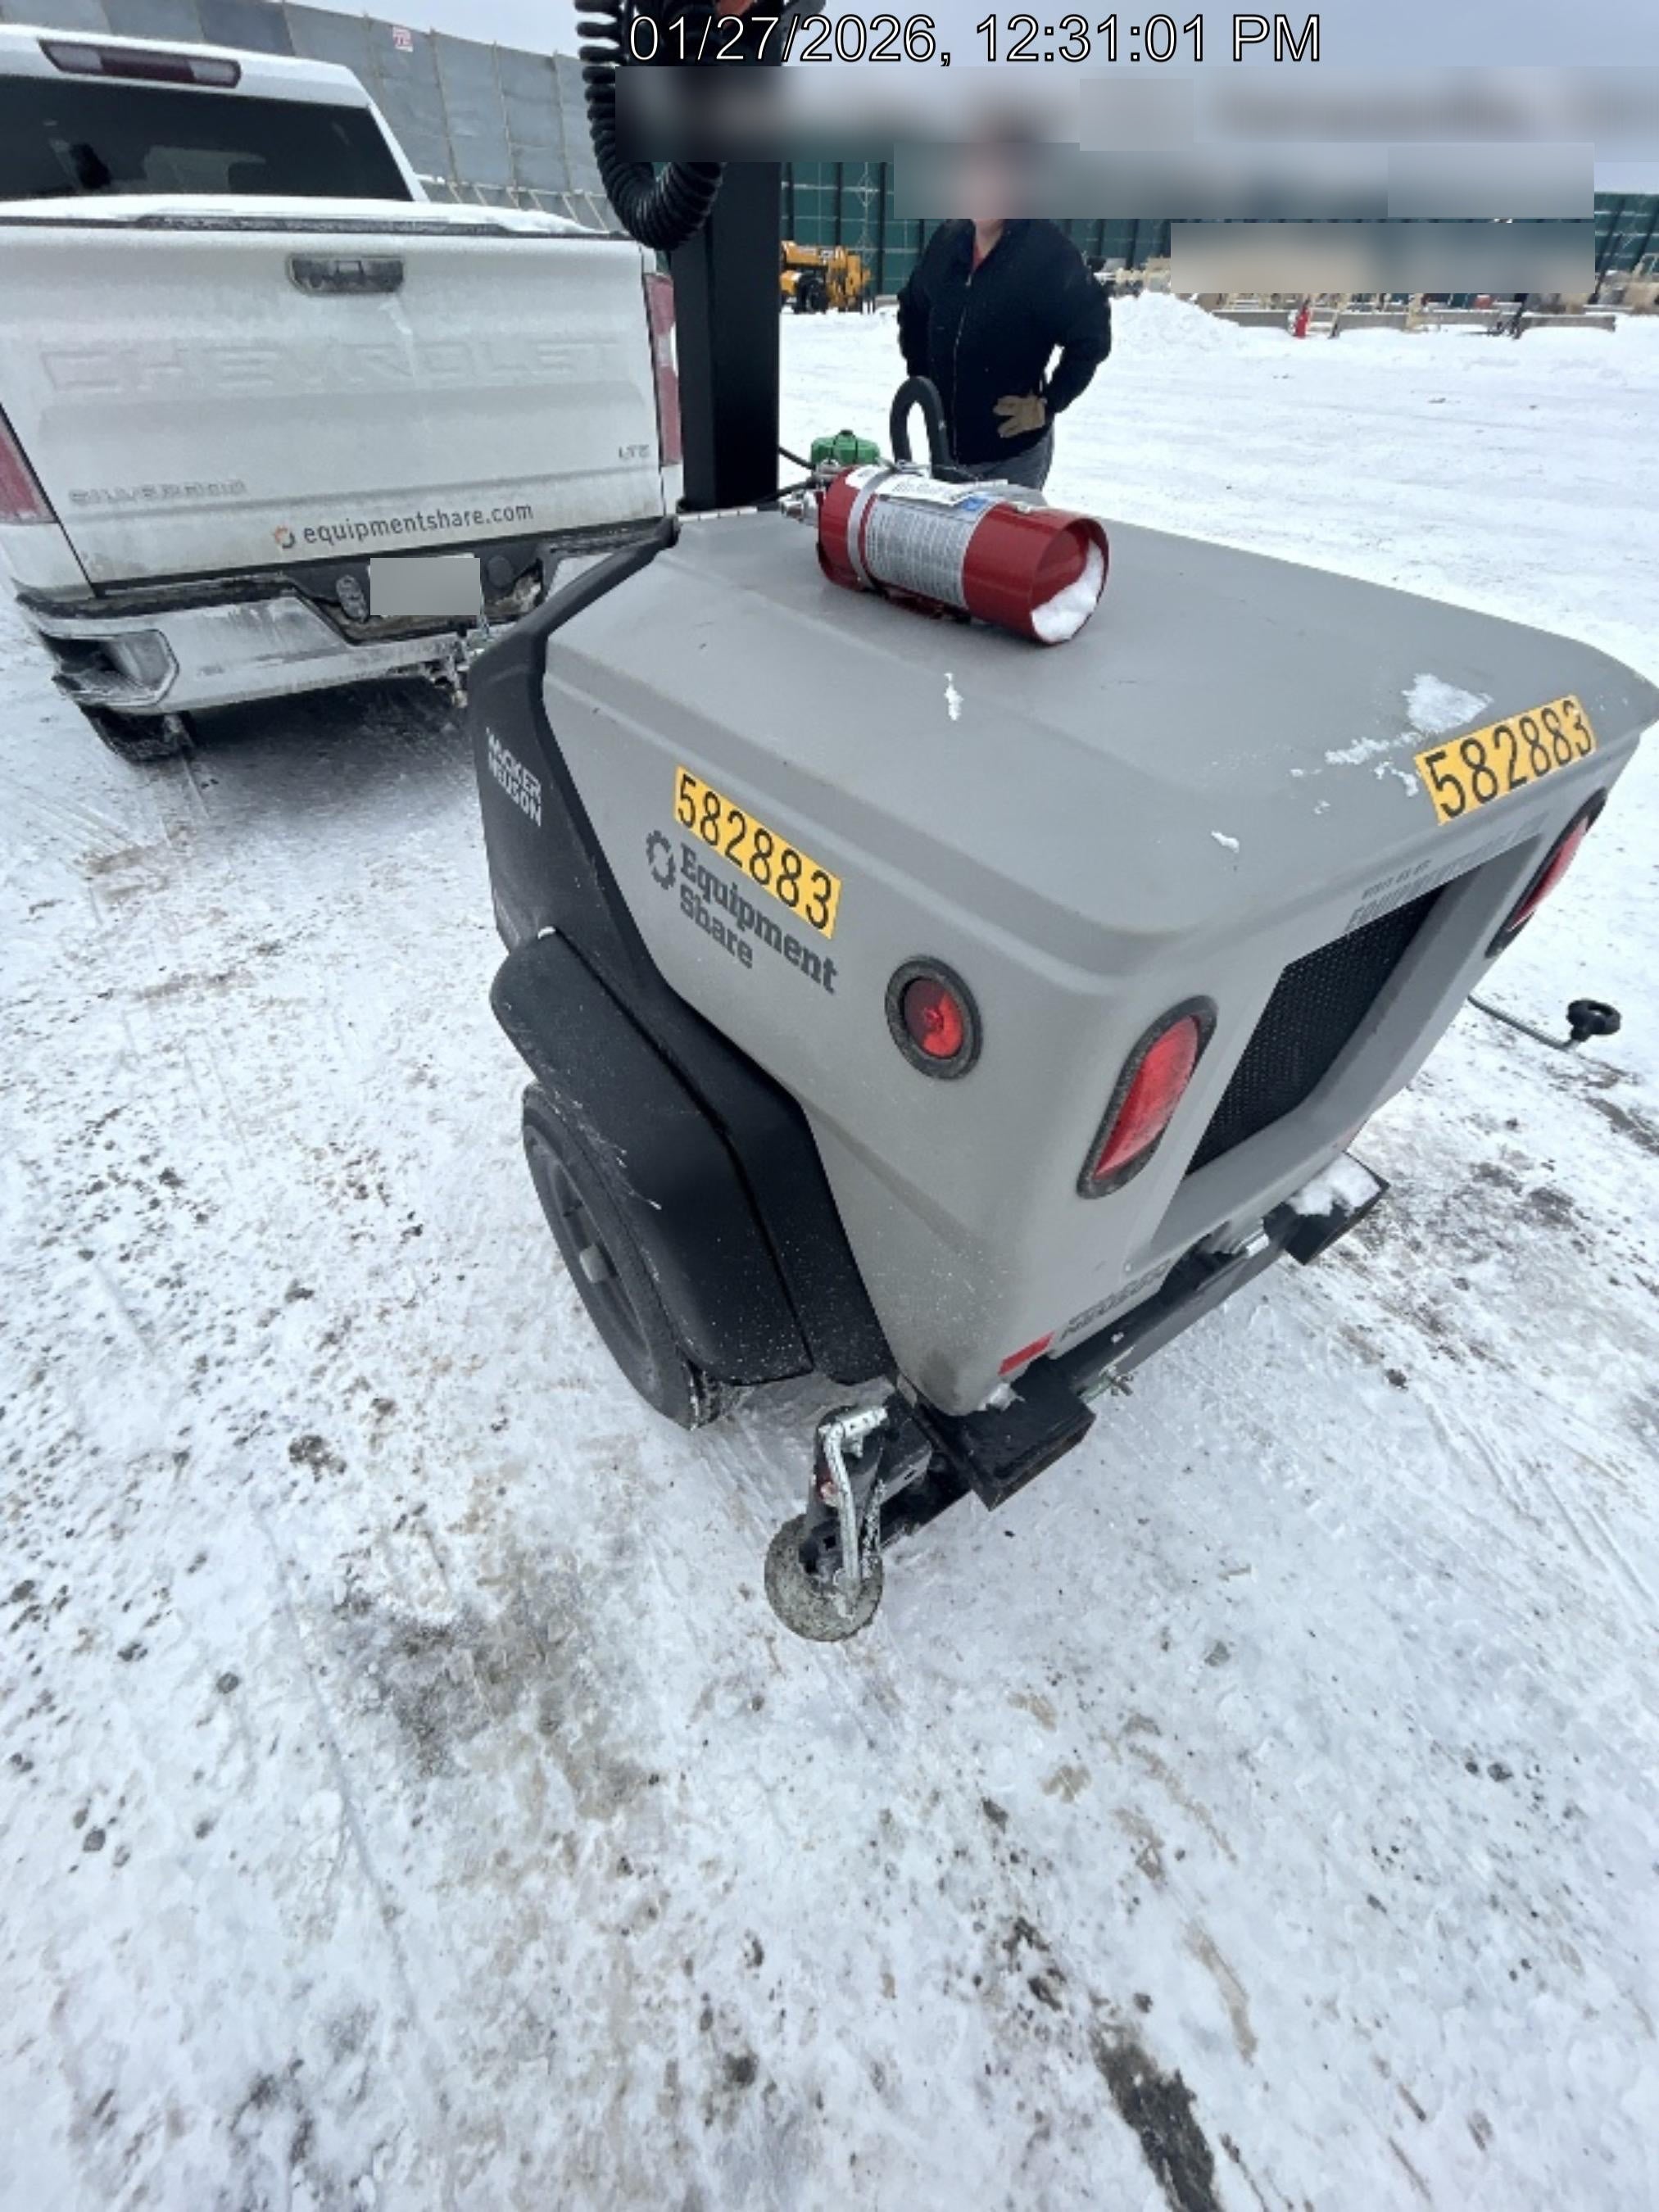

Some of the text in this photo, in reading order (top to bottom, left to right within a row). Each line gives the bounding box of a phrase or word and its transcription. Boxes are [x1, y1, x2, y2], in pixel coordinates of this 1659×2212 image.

[39, 340, 620, 394] CHEVROLET
[304, 504, 533, 546] equipmentshare.com
[1426, 700, 1592, 818] 582883
[678, 773, 832, 930] 582883
[681, 842, 838, 995] Equipment
[681, 883, 753, 969] Share
